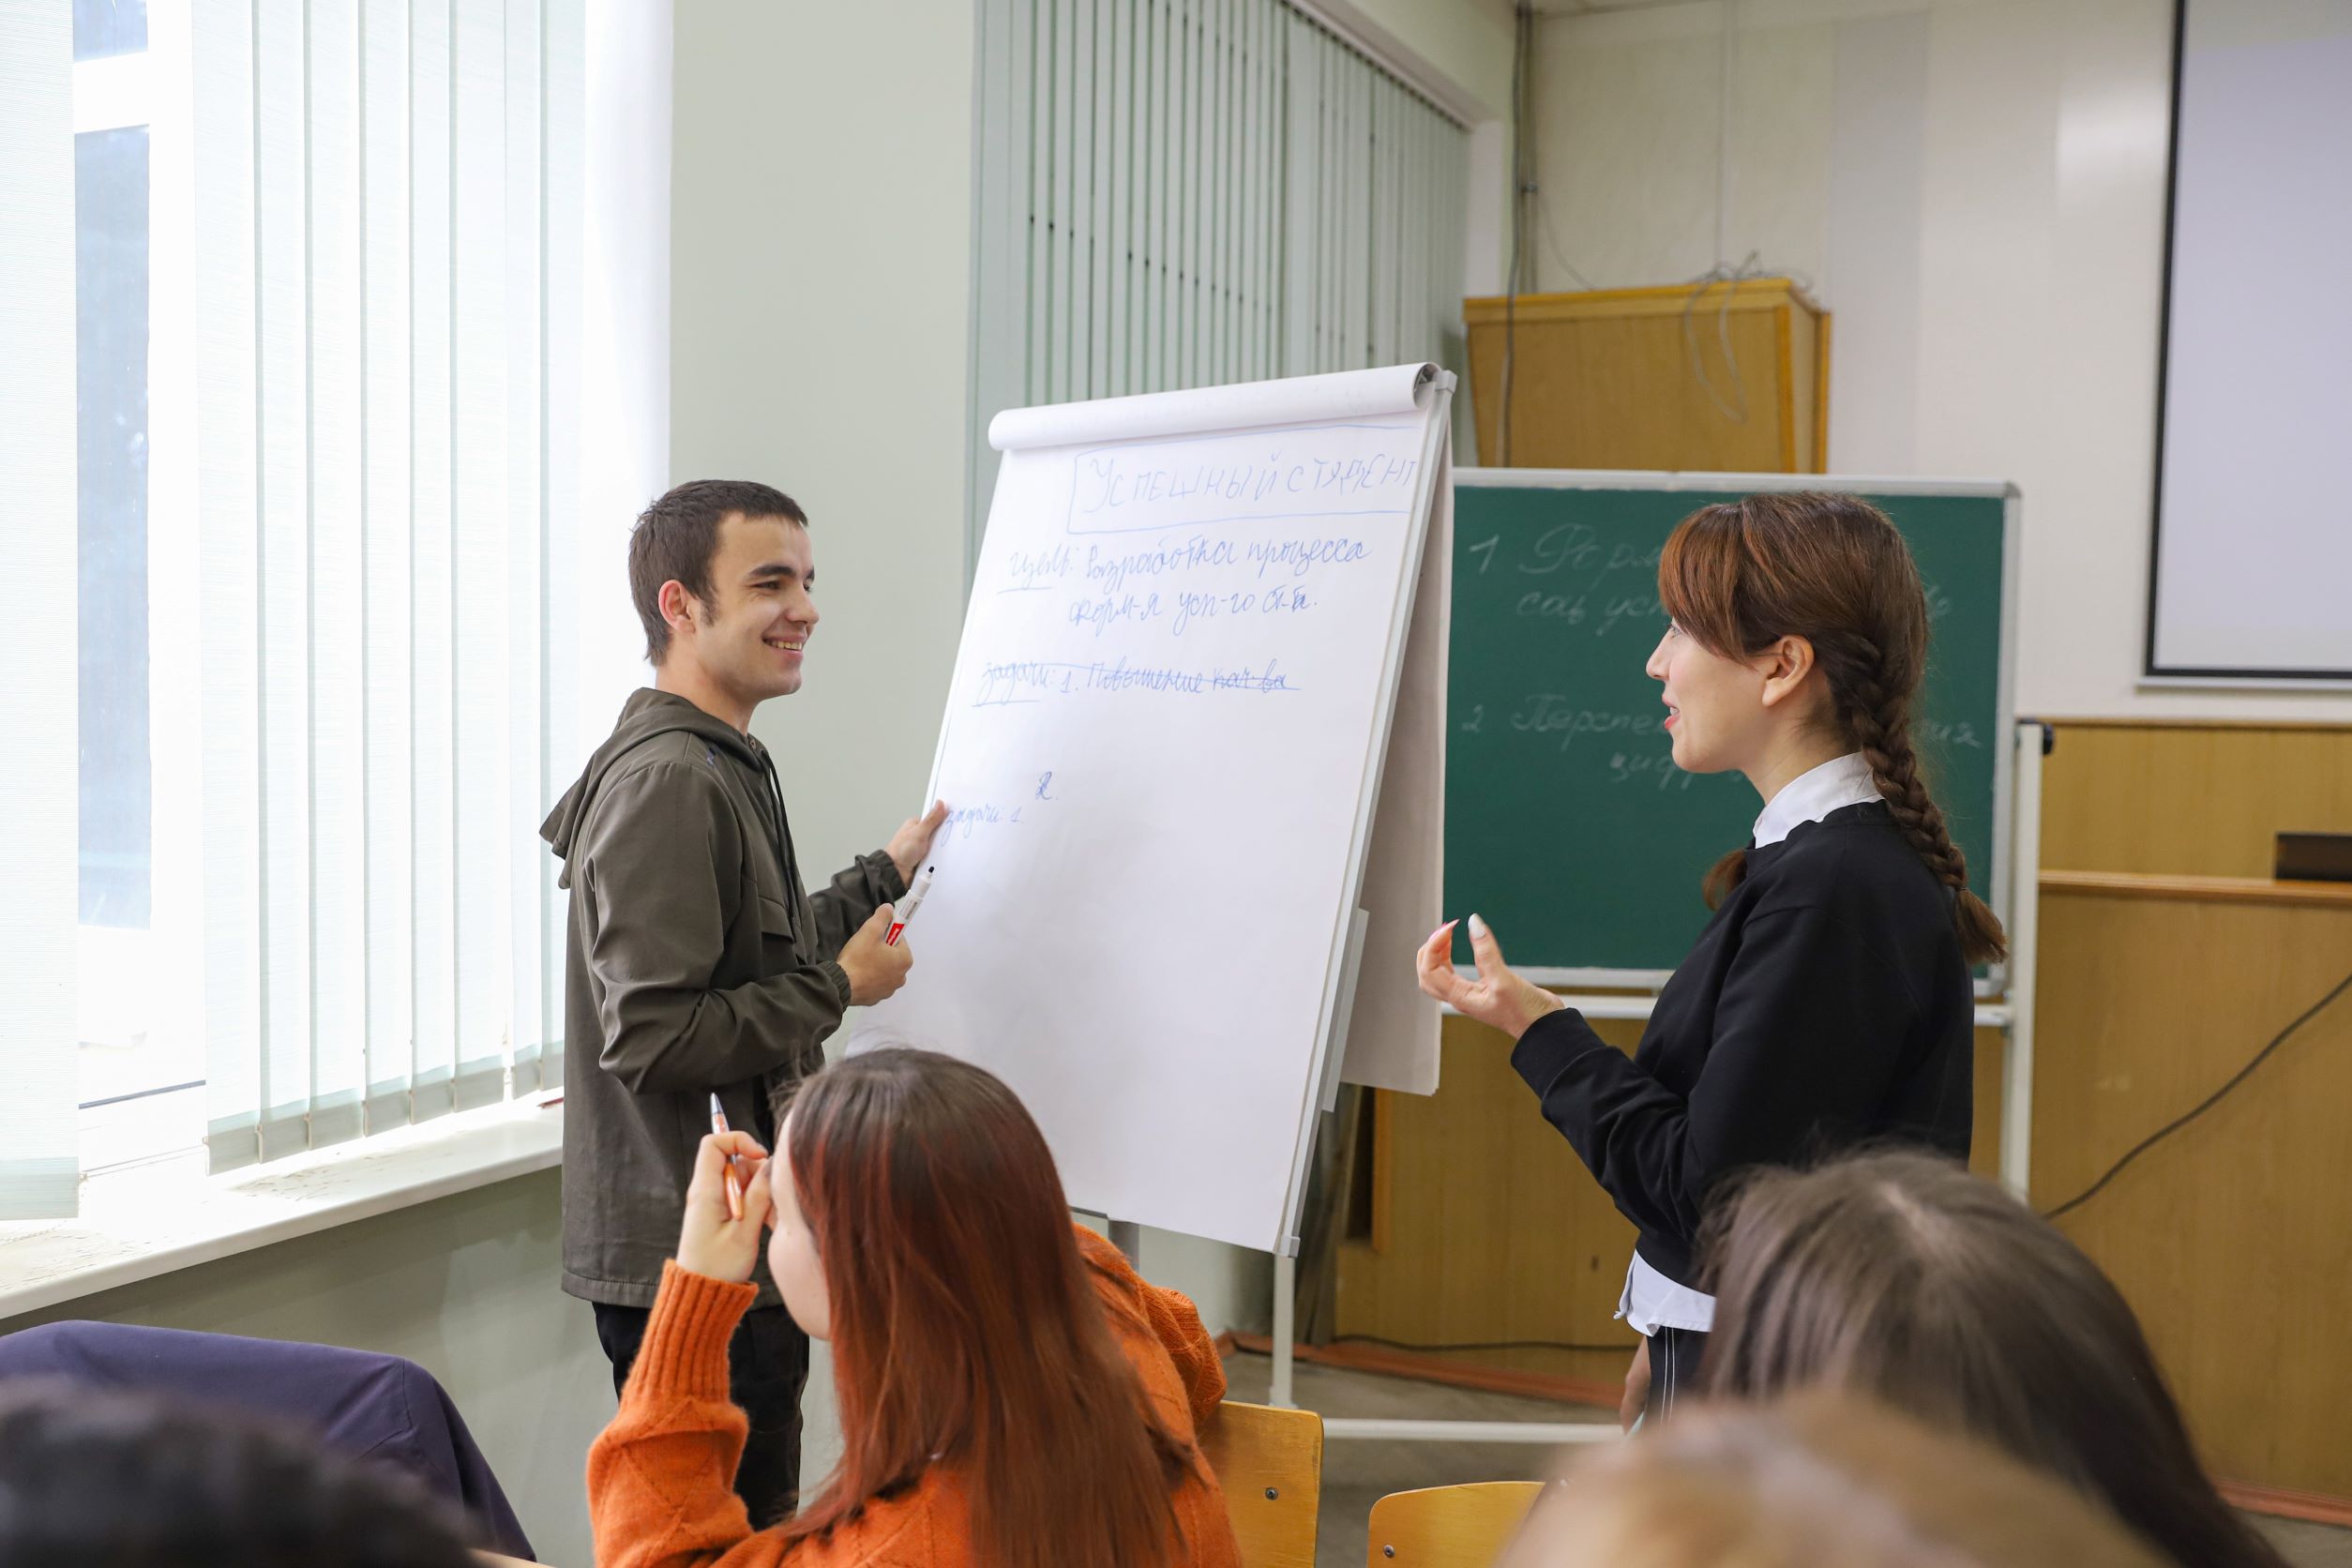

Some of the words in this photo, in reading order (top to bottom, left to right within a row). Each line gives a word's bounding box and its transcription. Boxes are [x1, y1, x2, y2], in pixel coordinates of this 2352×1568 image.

[1247, 537, 1373, 579] процесса
[1469, 533, 1500, 575] 1
[1460, 702, 1485, 734] 2
